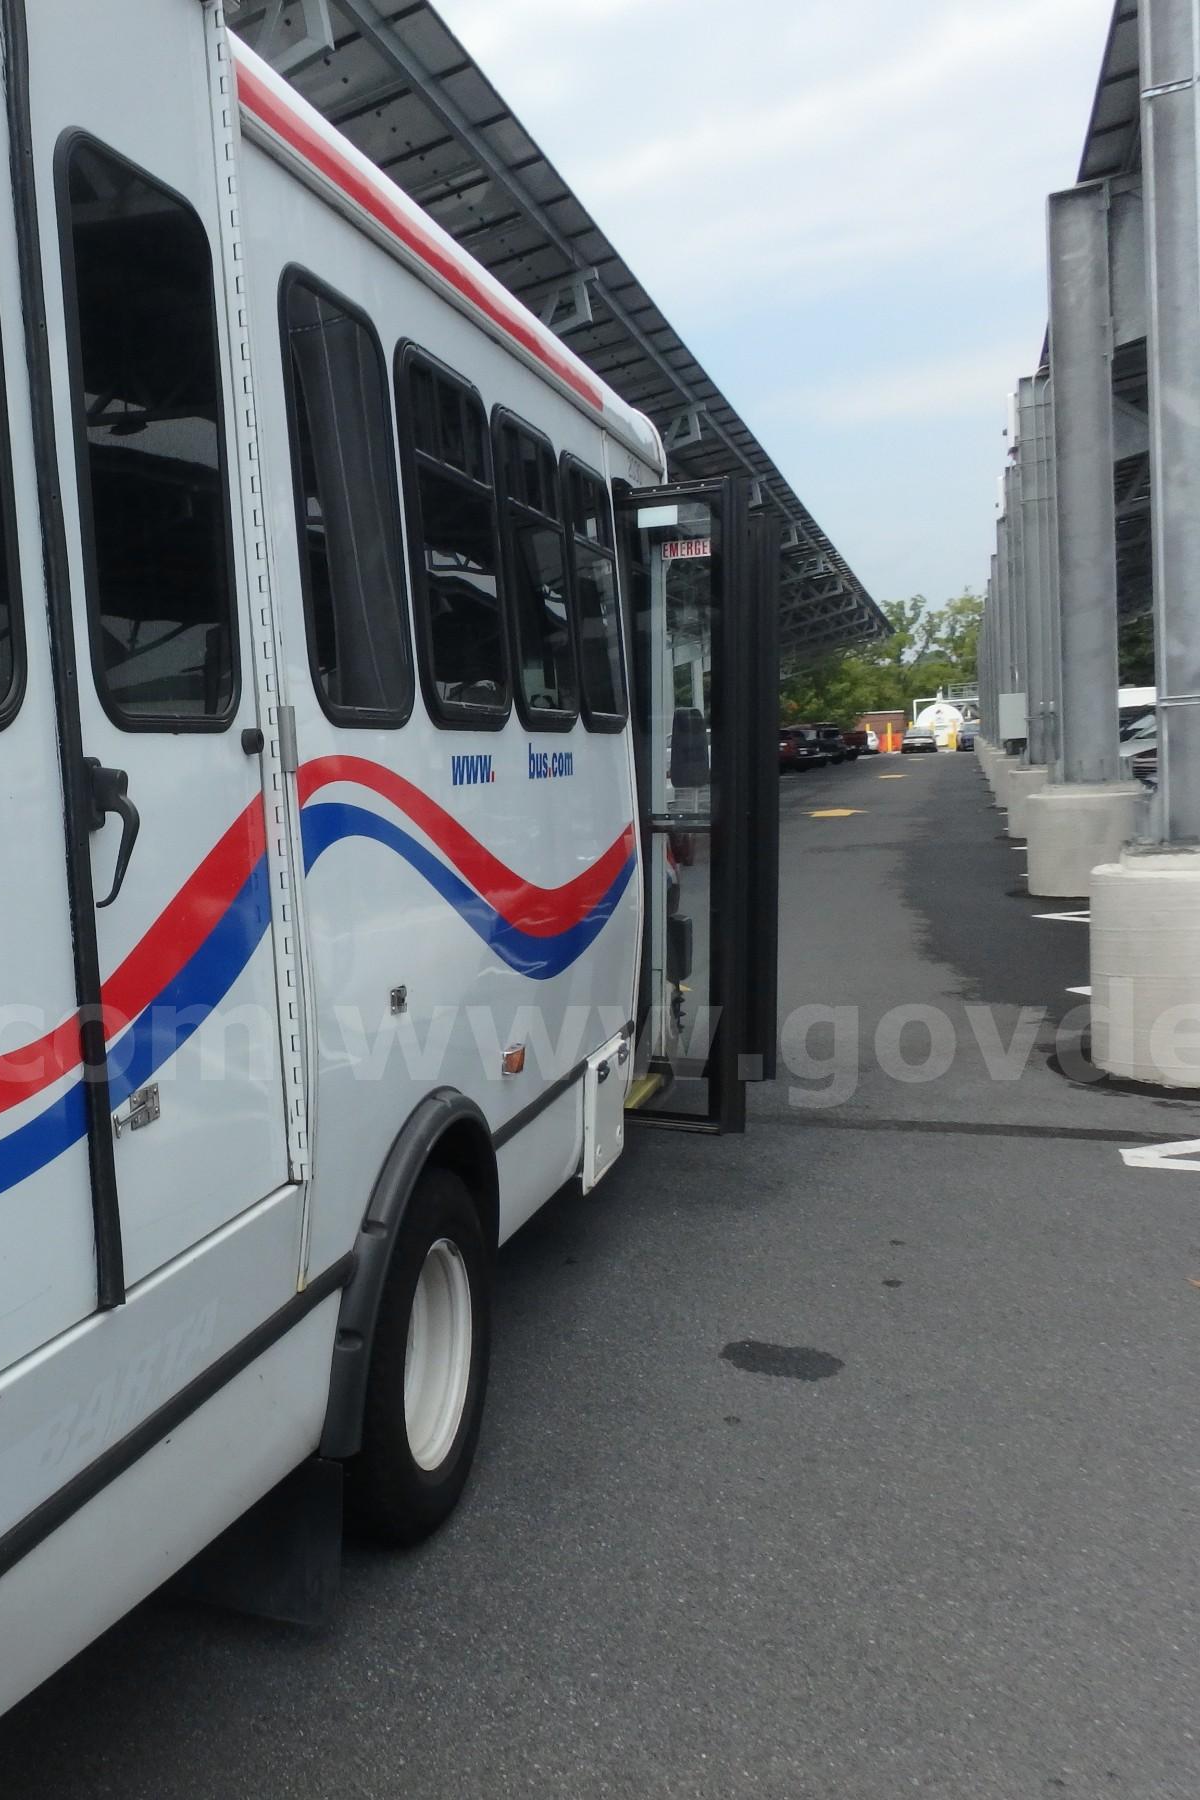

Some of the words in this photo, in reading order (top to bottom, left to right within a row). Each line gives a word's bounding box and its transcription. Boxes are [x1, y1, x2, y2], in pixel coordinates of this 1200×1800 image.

[663, 540, 710, 558] EMERGE
[452, 755, 495, 785] www.
[528, 742, 574, 779] bus.com
